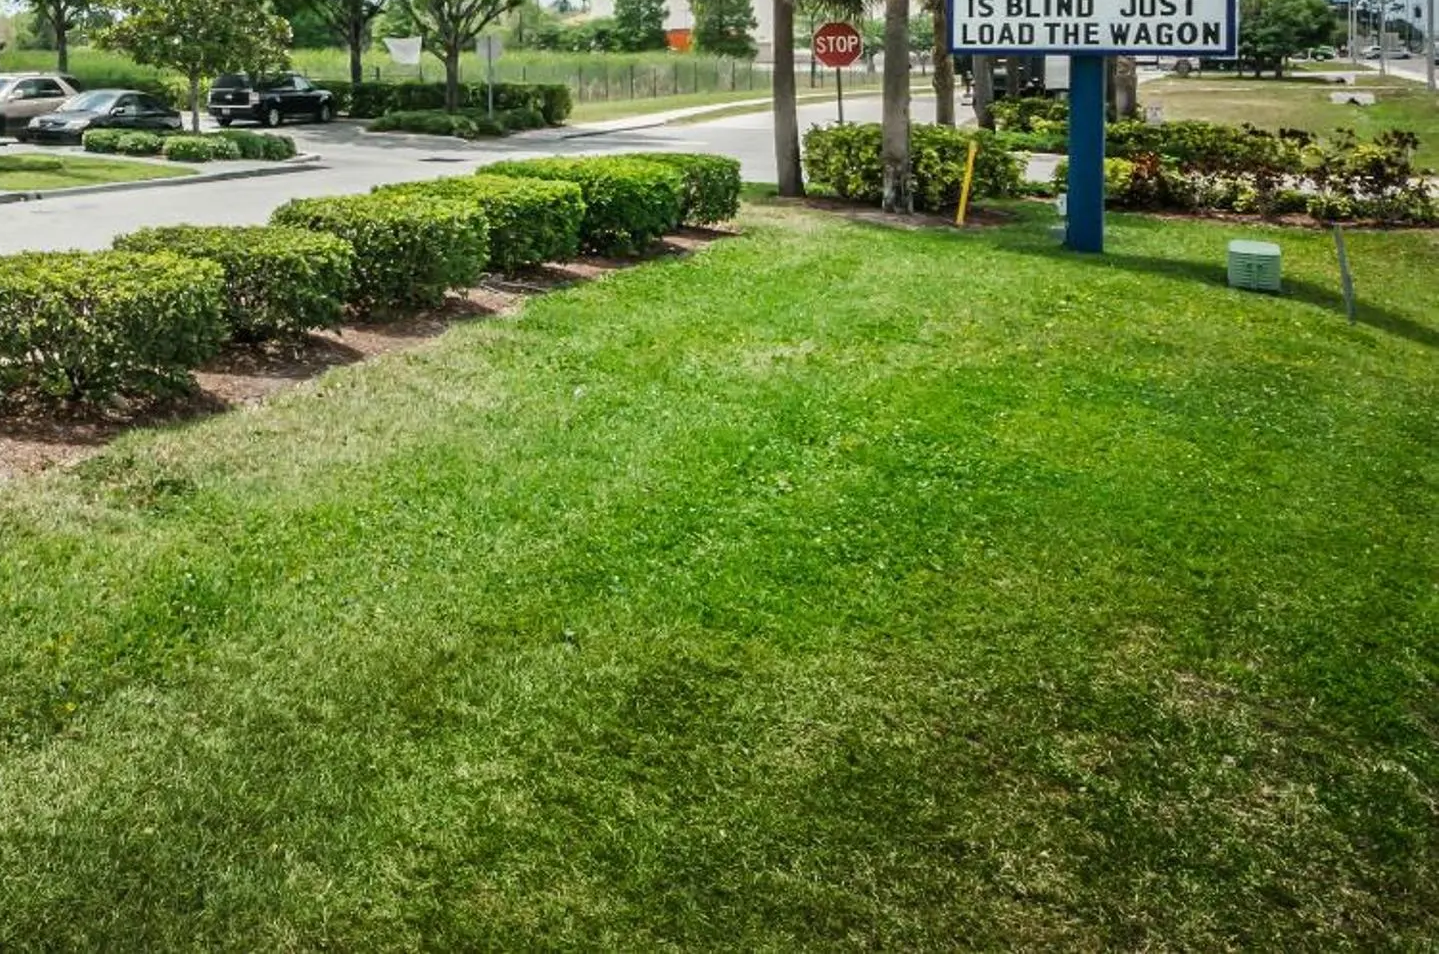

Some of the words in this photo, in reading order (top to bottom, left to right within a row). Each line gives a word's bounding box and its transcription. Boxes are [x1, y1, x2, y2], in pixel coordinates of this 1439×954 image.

[962, 23, 1035, 45] LOAD
[1044, 23, 1100, 45] THE
[1110, 22, 1221, 45] WAGON
[816, 35, 858, 54] STOP
